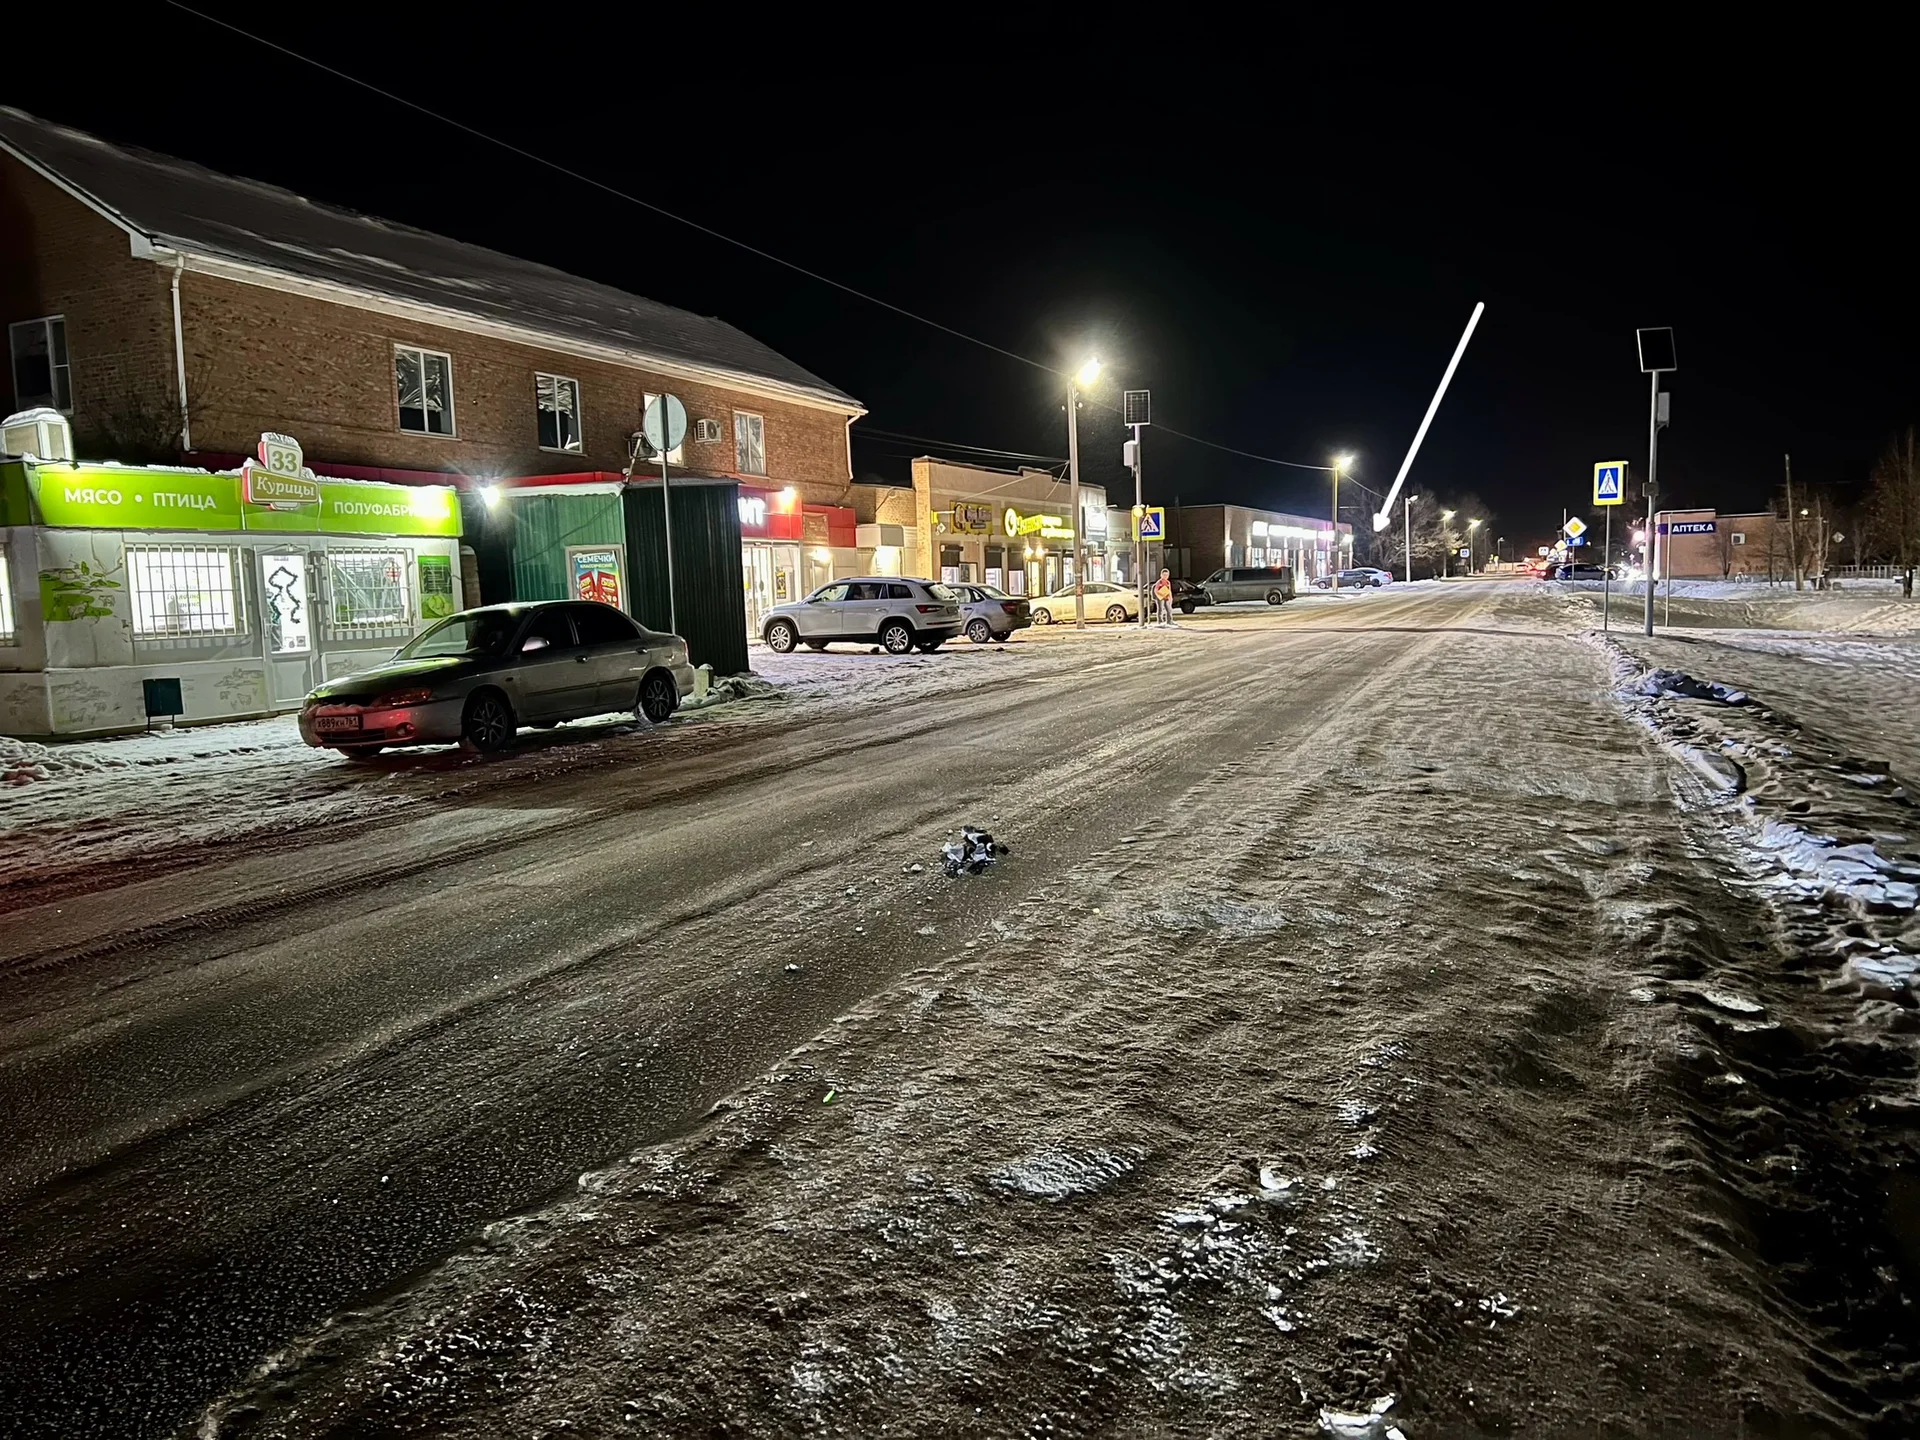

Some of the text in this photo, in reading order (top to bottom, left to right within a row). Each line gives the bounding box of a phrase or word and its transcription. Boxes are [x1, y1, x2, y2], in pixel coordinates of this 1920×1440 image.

[271, 450, 298, 472] 33
[255, 476, 316, 497] Курицы
[63, 487, 217, 511] МЯСО ПТИЦА
[334, 501, 451, 519] ПОЛУФАБР
[1672, 523, 1713, 532] АПТЕКА
[577, 554, 615, 563] СЕМЕЧКИ
